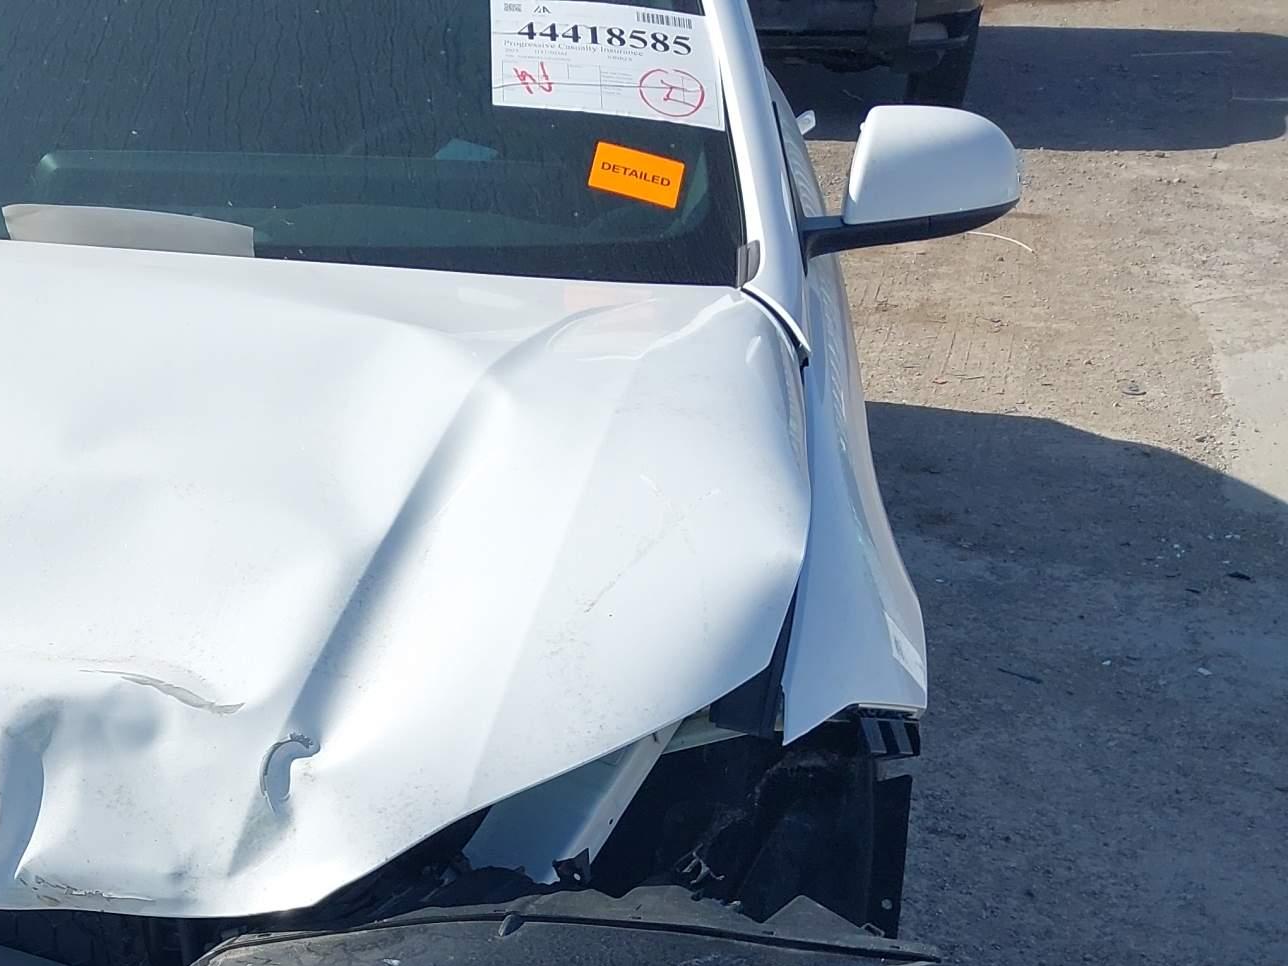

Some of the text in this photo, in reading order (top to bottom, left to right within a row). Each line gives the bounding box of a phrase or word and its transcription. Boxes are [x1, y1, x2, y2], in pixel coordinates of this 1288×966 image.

[504, 40, 644, 57] Progressive Casualty Insurance
[518, 21, 692, 56] 44418585
[601, 161, 671, 187] DETAILED
